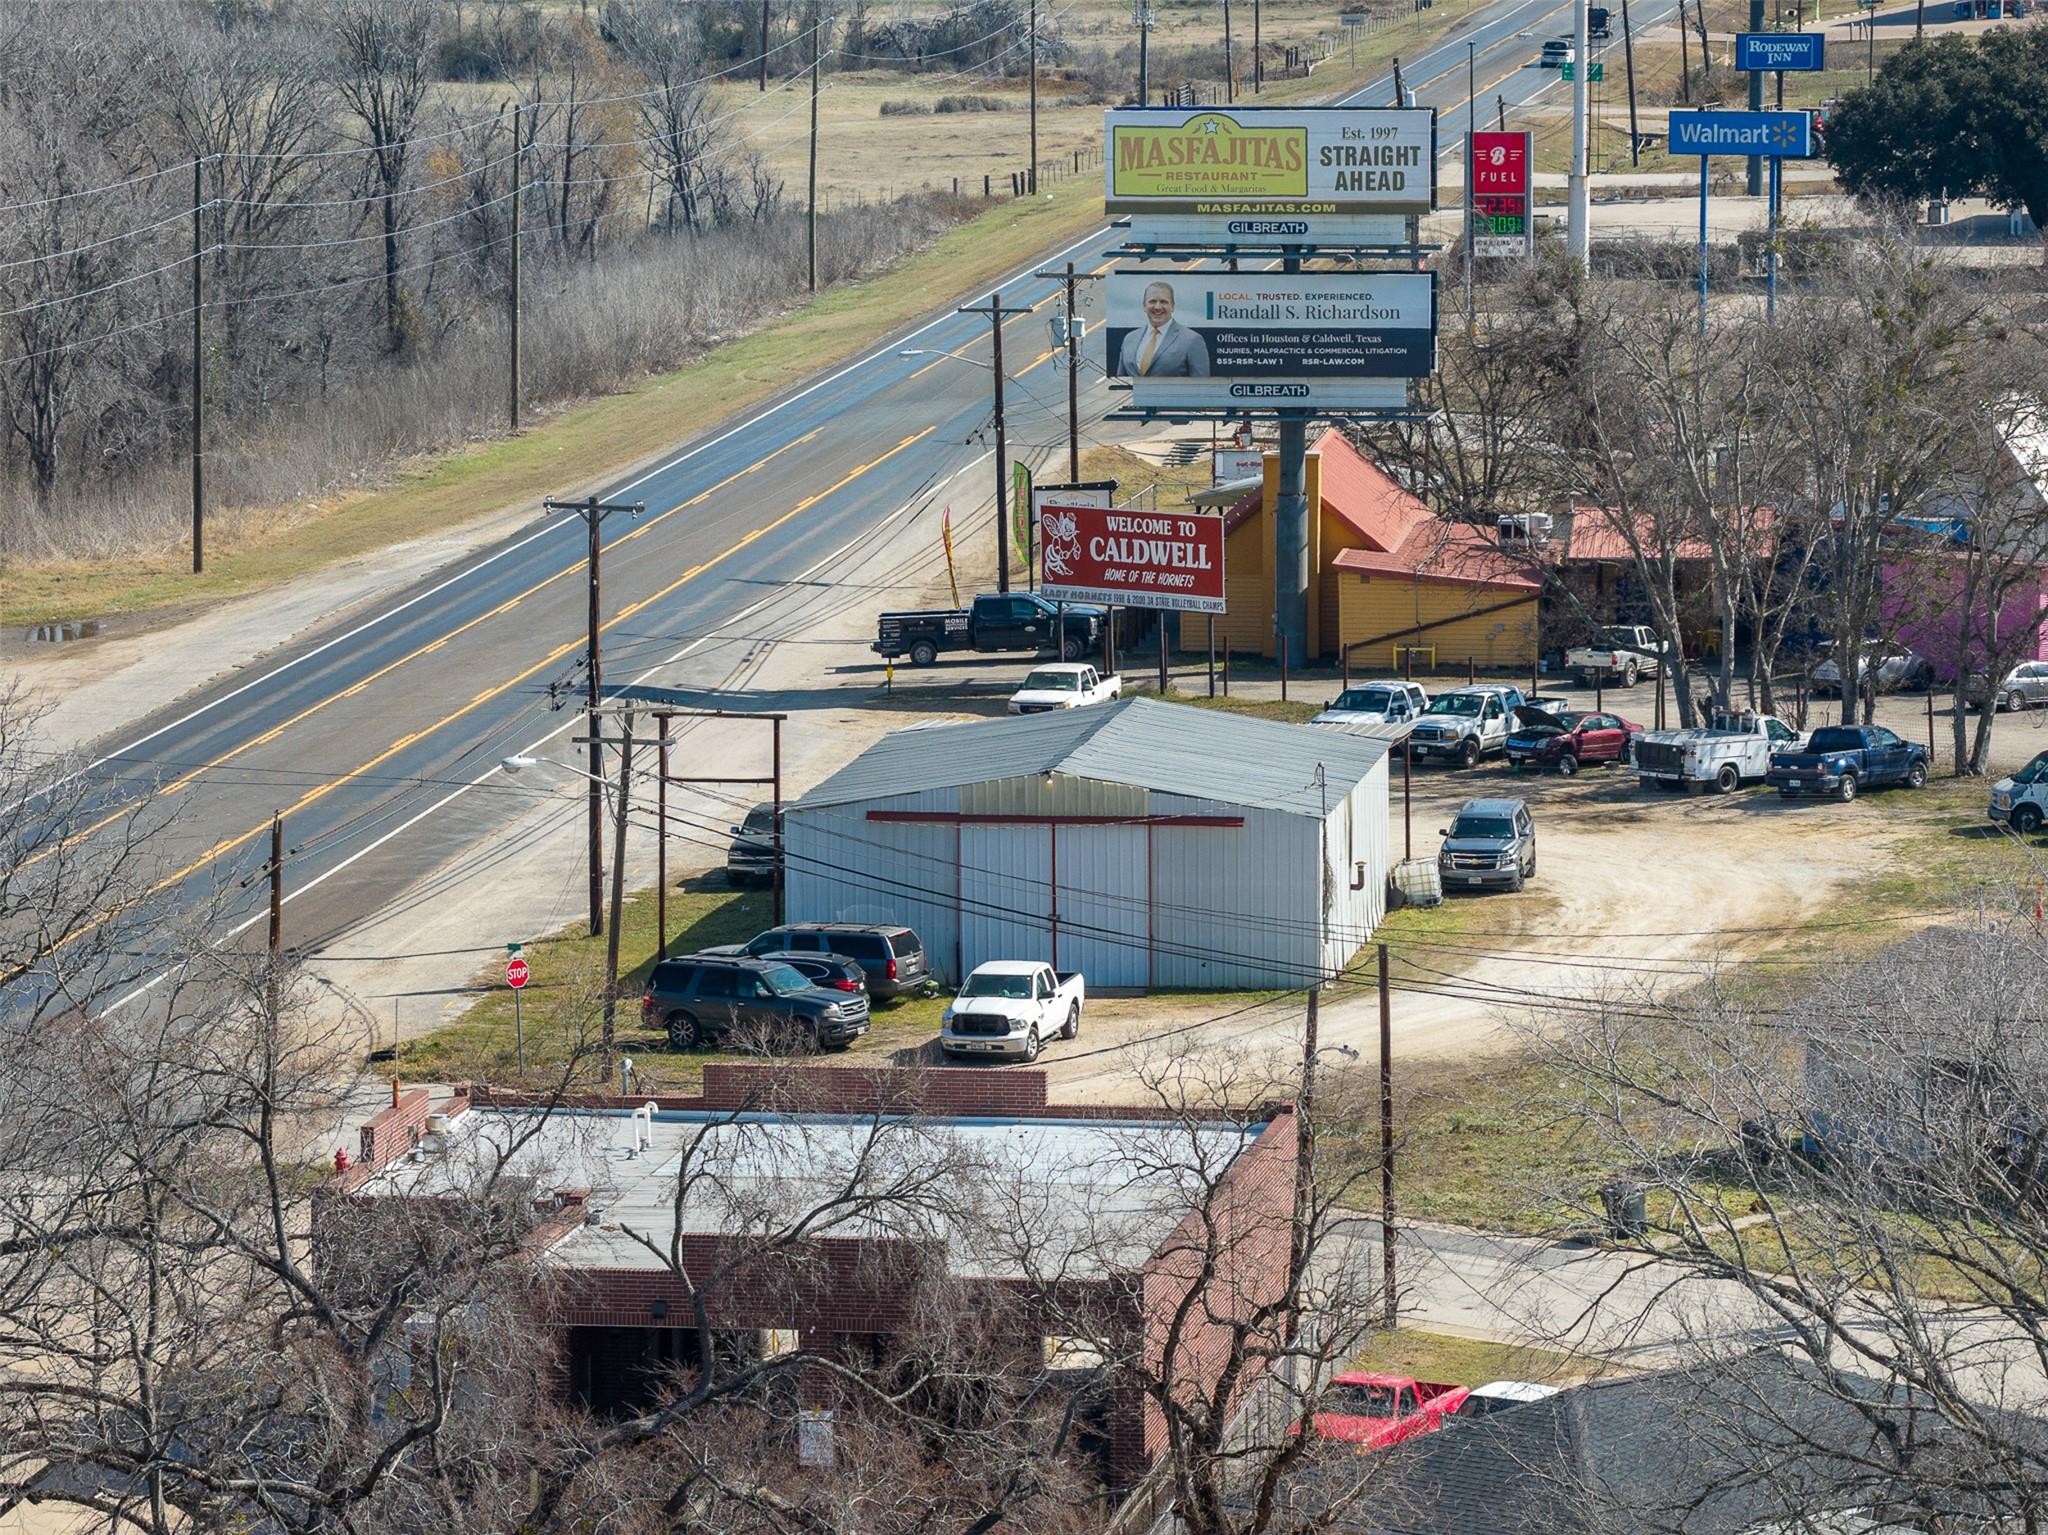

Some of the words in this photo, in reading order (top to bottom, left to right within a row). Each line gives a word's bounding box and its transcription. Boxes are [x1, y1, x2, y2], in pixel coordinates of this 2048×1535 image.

[1750, 40, 1810, 52] RODEWAY
[1767, 53, 1792, 64] INN
[1342, 127, 1365, 139] Est.
[1371, 127, 1398, 140] 1997
[1680, 123, 1769, 144] Walmart
[1119, 136, 1302, 172] MASFAJITAS
[1320, 145, 1421, 167] STRAIGHT
[1166, 172, 1258, 181] RESTAURANT
[1334, 171, 1405, 191] AHEAD
[1480, 172, 1517, 182] FUEL
[1156, 184, 1182, 193] Great
[1185, 184, 1208, 193] Food
[1210, 184, 1218, 193] &
[1220, 184, 1267, 195] Margaritas
[1197, 203, 1336, 213] MASFAJITAS.COM
[1231, 222, 1305, 233] GILBREATH
[1256, 293, 1302, 301] TRUSTED.
[1305, 293, 1374, 301] EXPERIENCED.
[1218, 304, 1280, 320] Randall
[1285, 305, 1300, 320] S.
[1305, 304, 1400, 320] Richardson
[1216, 333, 1248, 343] Offices
[1250, 333, 1260, 343] in
[1262, 334, 1300, 343] Houston
[1301, 334, 1311, 343] &
[1355, 334, 1382, 343] Texas
[1233, 385, 1307, 397] GILBREATH
[1106, 515, 1172, 535] WELCOME
[1177, 521, 1196, 537] TO
[1089, 536, 1212, 570] CALDWELL
[1104, 567, 1127, 582] HOME
[1128, 569, 1140, 583] OF
[1141, 570, 1157, 584] THE
[1157, 572, 1195, 588] HORNETS
[1044, 589, 1069, 599] LADY
[1070, 590, 1112, 601] HORNETS
[1155, 596, 1170, 607] STATE
[1170, 598, 1202, 610] VOLLEYBALL
[1202, 600, 1224, 611] CHAMPS
[507, 967, 528, 980] STOP
